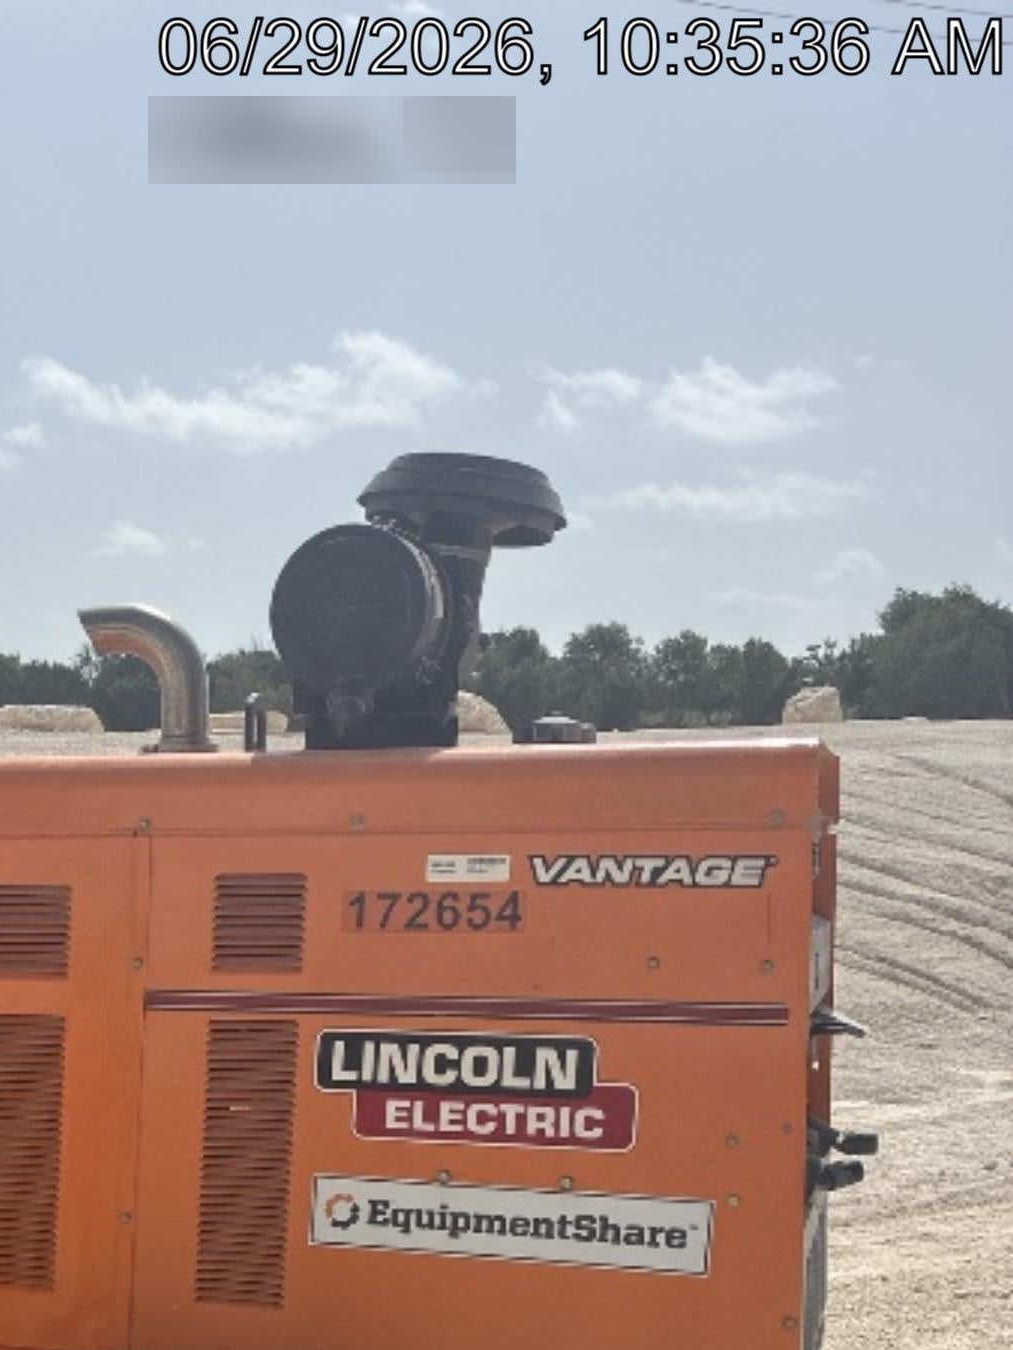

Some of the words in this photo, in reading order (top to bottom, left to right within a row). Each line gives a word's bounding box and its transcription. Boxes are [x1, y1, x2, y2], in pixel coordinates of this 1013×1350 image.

[530, 855, 772, 888] VANTAGE
[347, 891, 523, 931] 172654
[330, 1039, 580, 1092] LINCOLN
[384, 1100, 606, 1140] ELECTRIC
[365, 1199, 689, 1250] EquipmentShare
